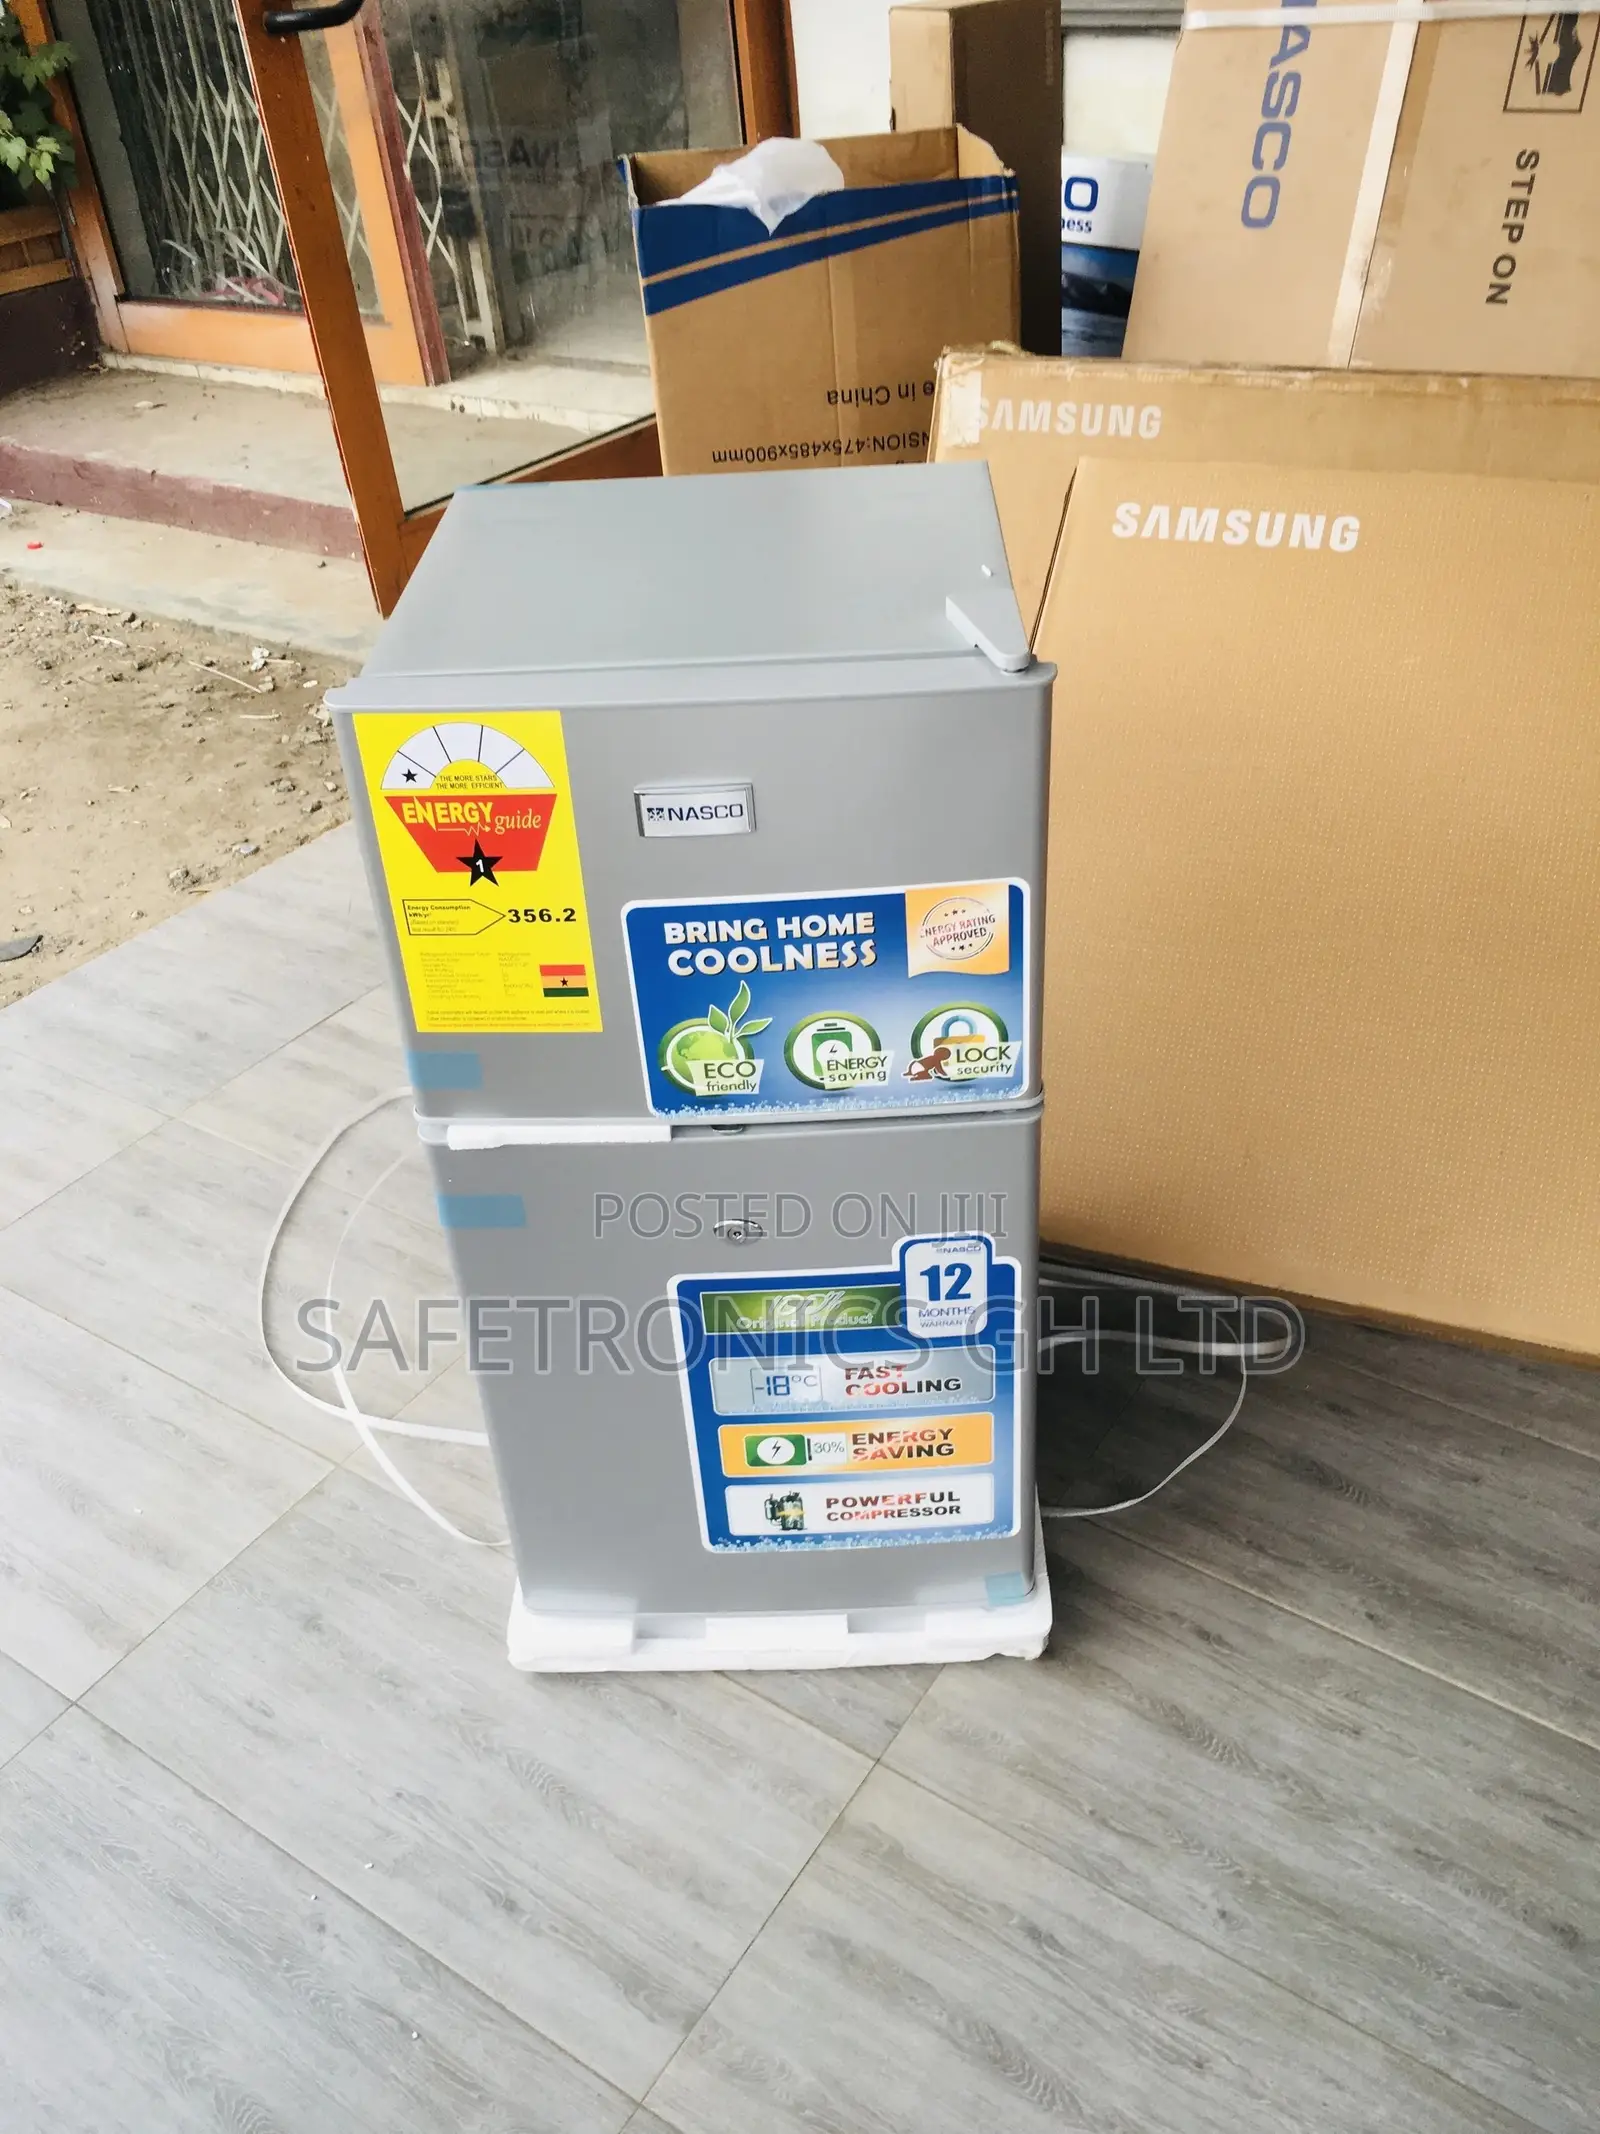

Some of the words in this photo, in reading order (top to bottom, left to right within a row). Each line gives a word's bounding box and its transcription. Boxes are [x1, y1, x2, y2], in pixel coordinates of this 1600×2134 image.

[1241, 0, 1317, 229] ASCO
[1501, 148, 1540, 244] STEP
[1485, 253, 1517, 305] ON
[827, 387, 890, 408] China
[898, 383, 916, 401] in
[1112, 502, 1360, 553] SAMSUNG
[475, 774, 498, 782] STARS
[401, 797, 494, 832] ENERGY
[494, 808, 542, 835] guide
[667, 803, 744, 821] NASCO
[475, 859, 485, 873] 1
[430, 904, 471, 912] Consumption
[507, 907, 577, 924] 356.2
[663, 918, 768, 946] BRING
[776, 911, 876, 940] HOME
[959, 914, 996, 930] RATING
[933, 927, 987, 947] APPROVED
[667, 939, 877, 977] COOLNESS
[826, 1054, 888, 1072] ENERGY
[955, 1045, 1011, 1063] LOCK
[703, 1060, 757, 1079] ECO
[829, 1069, 888, 1084] saving
[956, 1061, 1013, 1077] security
[706, 1079, 758, 1093] friendly
[920, 1263, 972, 1302] 12
[918, 1305, 976, 1318] MONTHS
[845, 1364, 908, 1380] FAST
[845, 1378, 962, 1397] COOLING
[851, 1428, 954, 1446] ENERGY
[813, 1440, 845, 1454] 30%
[852, 1443, 955, 1462] SAVING
[825, 1491, 961, 1508] POWERFUL
[826, 1505, 961, 1522] COMPRESSOR
